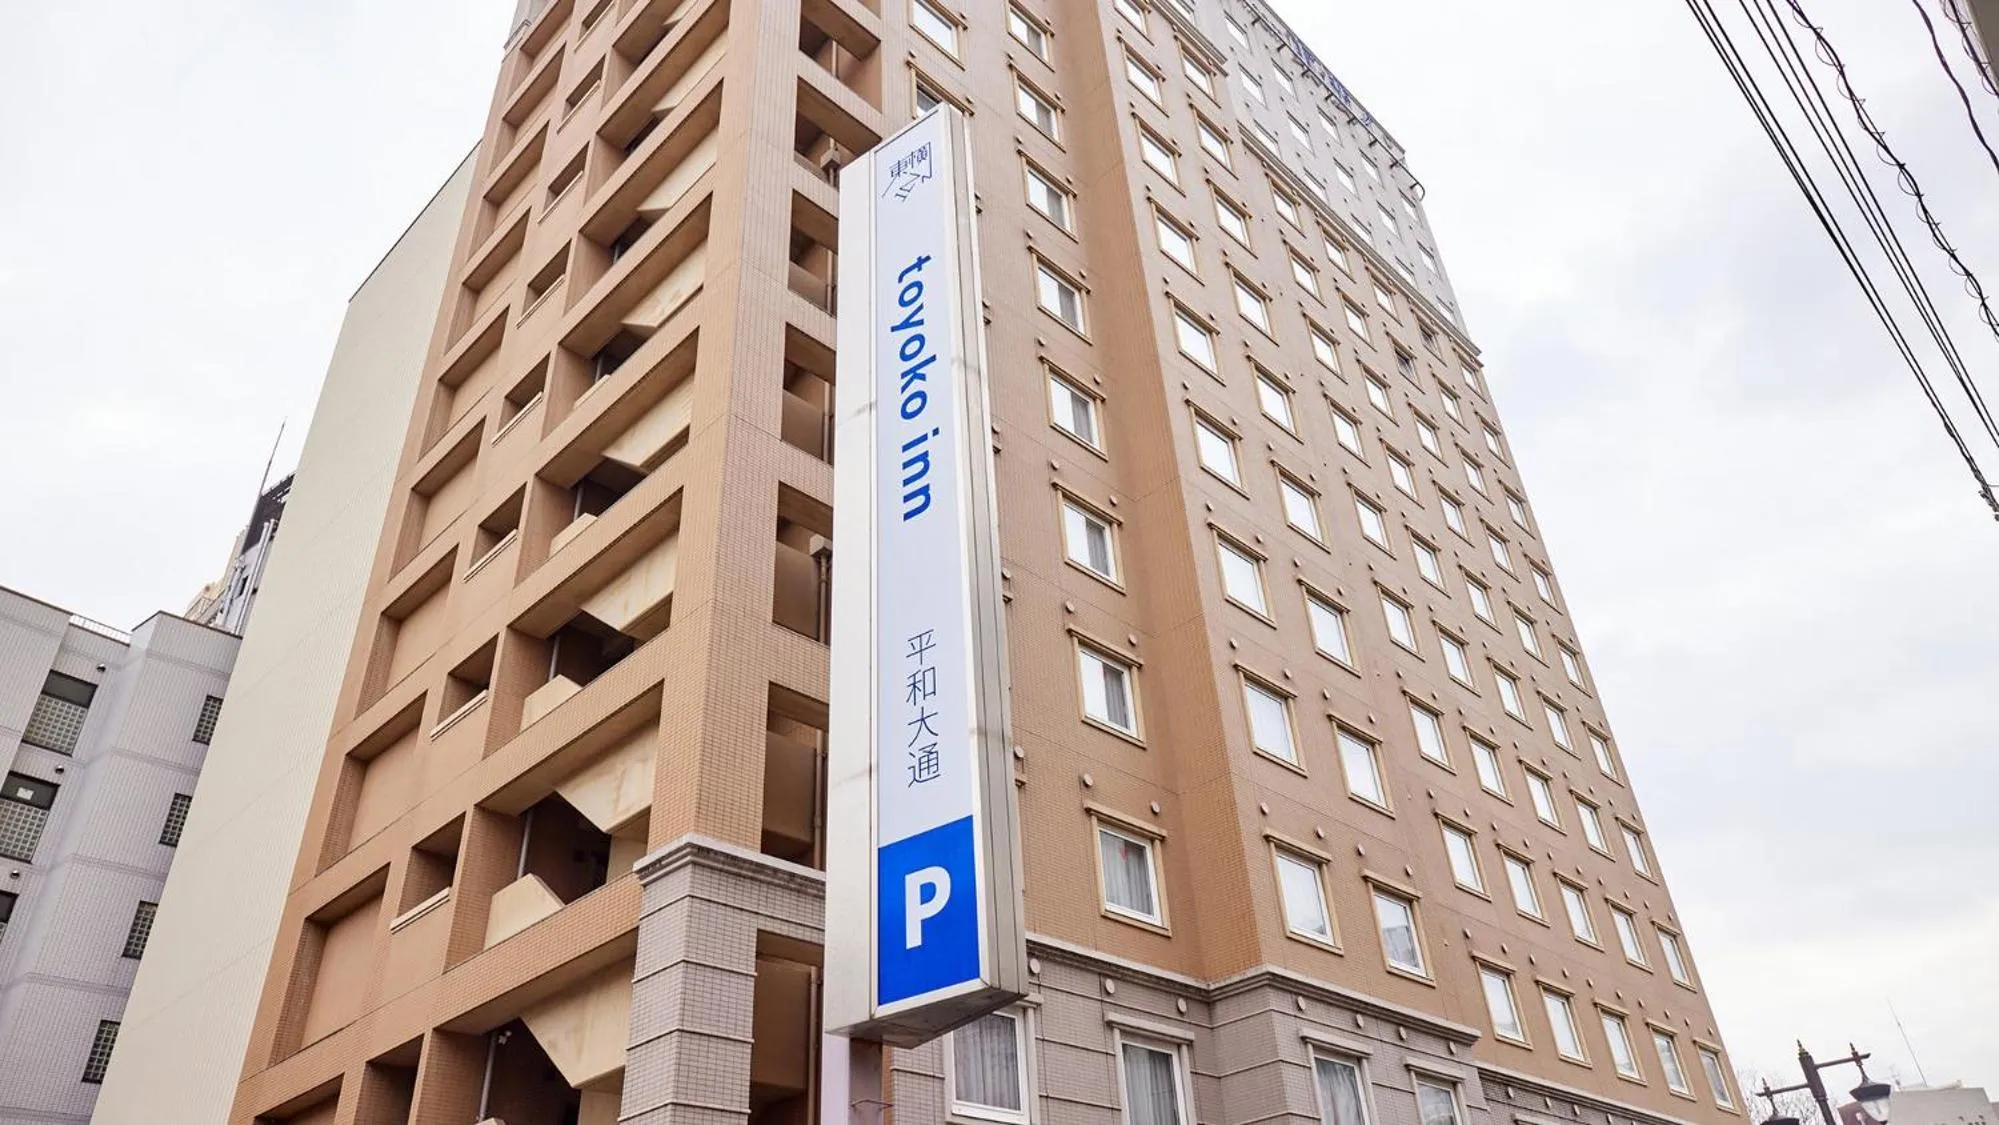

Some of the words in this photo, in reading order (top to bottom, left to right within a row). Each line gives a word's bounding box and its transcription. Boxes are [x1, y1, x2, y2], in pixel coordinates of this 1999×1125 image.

[890, 255, 937, 421] toyoko
[902, 427, 941, 521] inn
[905, 628, 942, 788] 平和大通
[904, 865, 951, 950] P
